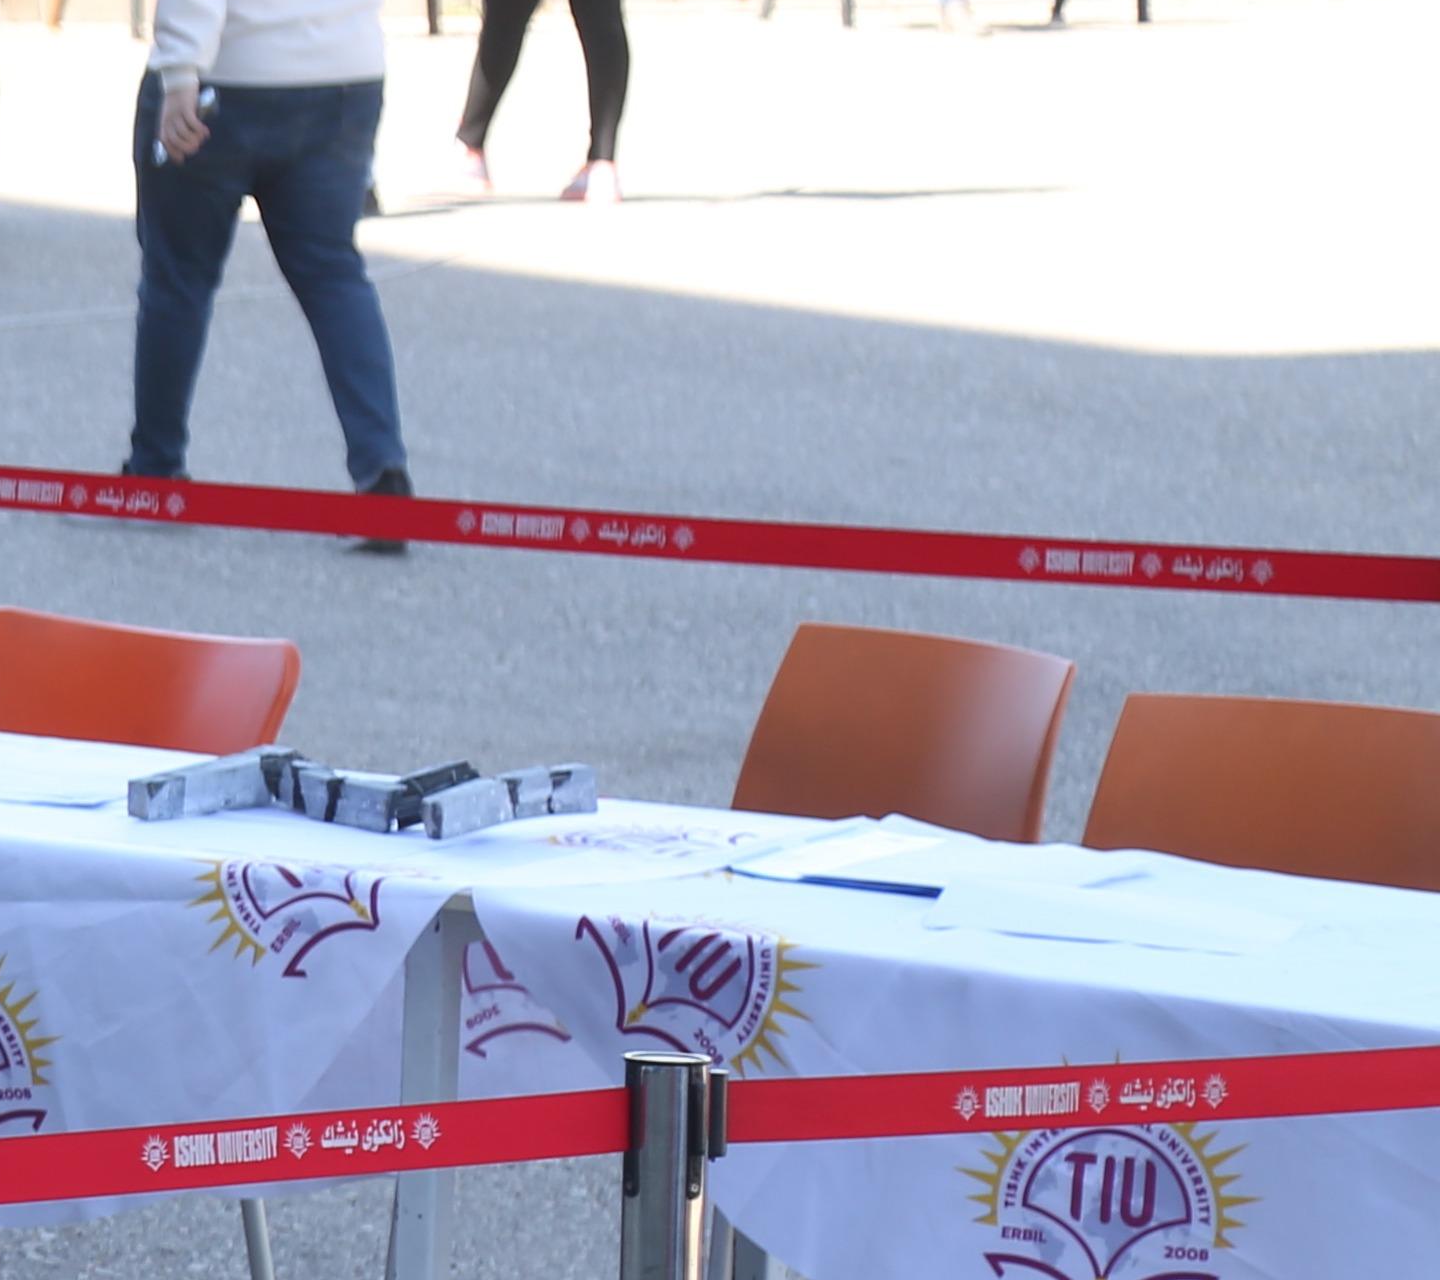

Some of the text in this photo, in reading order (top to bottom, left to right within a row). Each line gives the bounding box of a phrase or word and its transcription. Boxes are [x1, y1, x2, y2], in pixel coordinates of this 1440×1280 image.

[174, 1125, 278, 1168] ISHIK UNIVERSITY
[1159, 1131, 1211, 1227] UNIVERSITY
[1064, 1151, 1157, 1228] TIU
